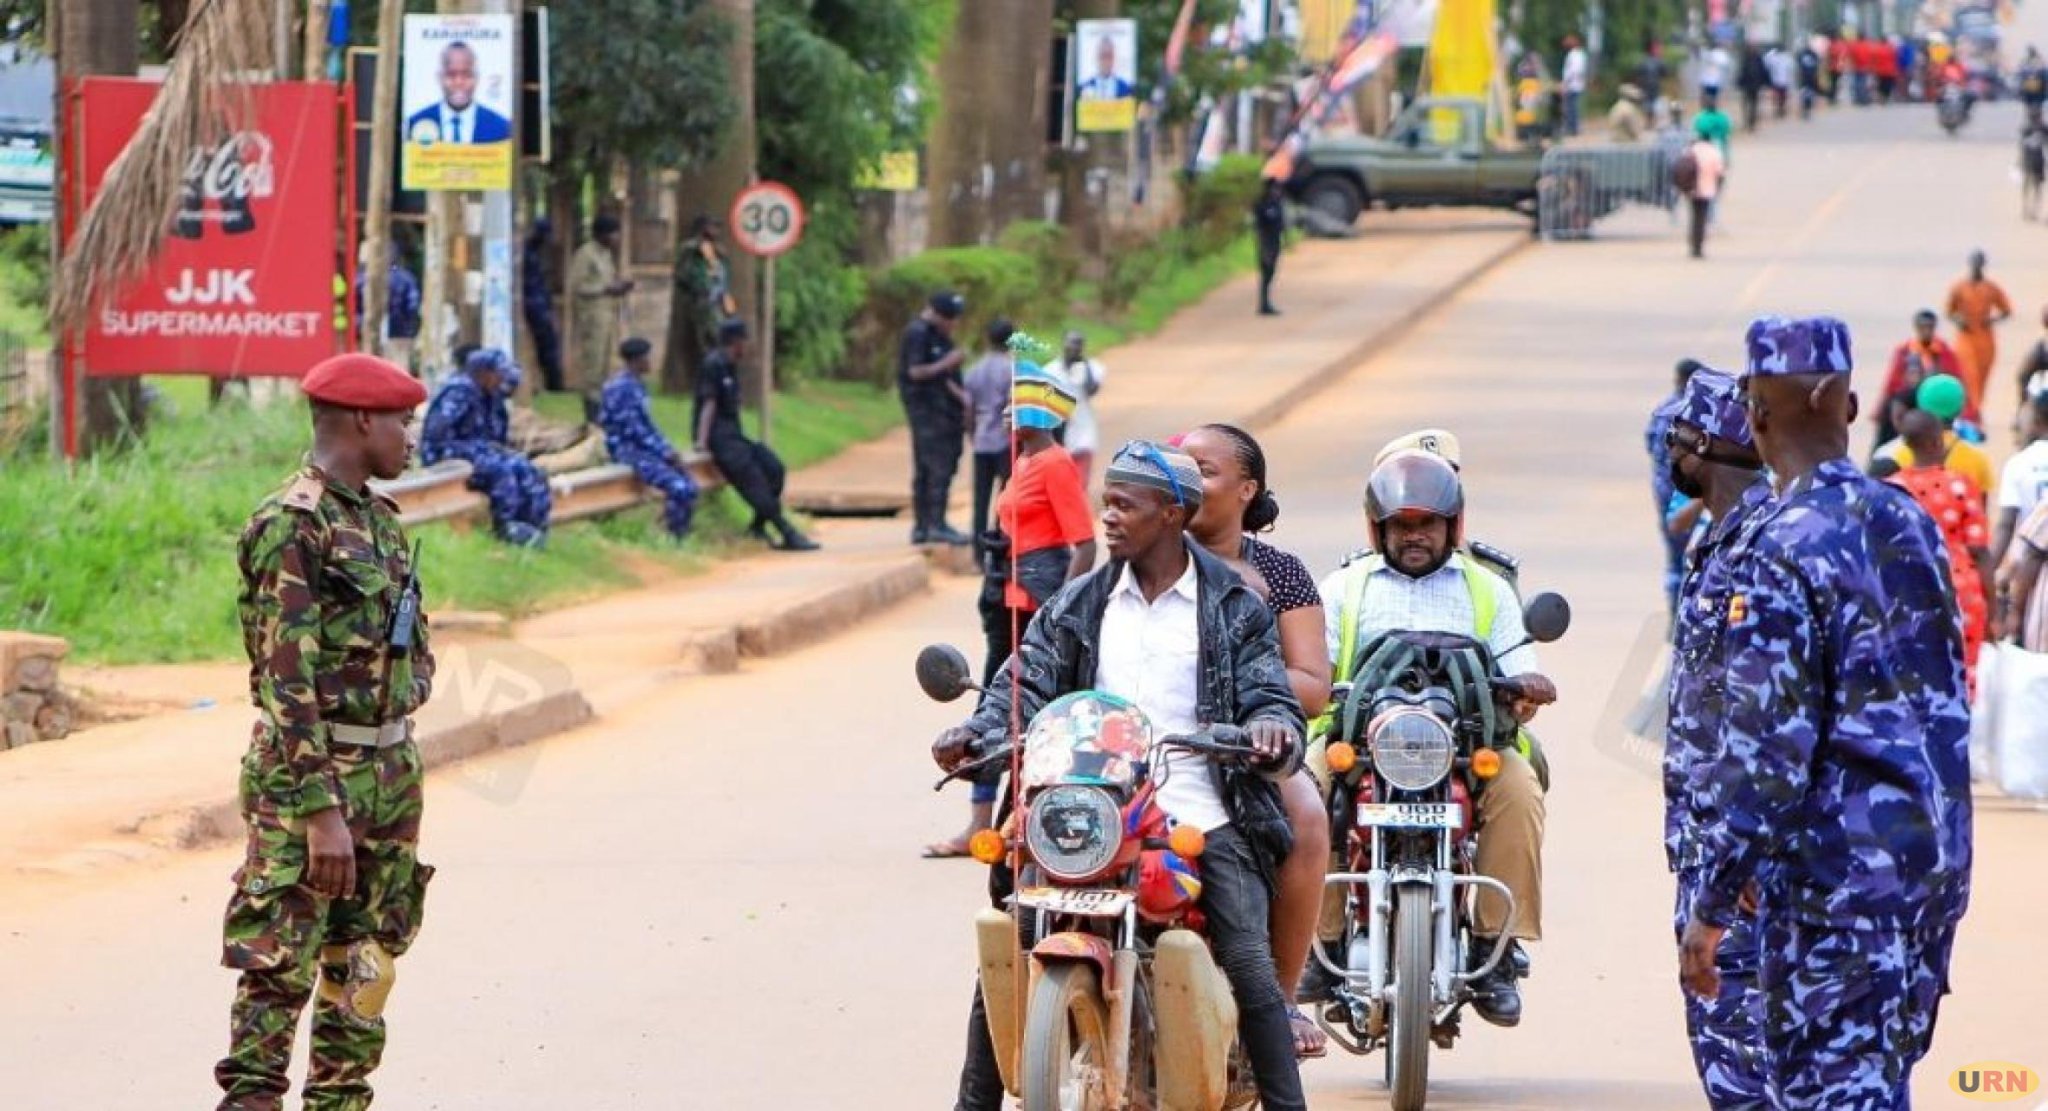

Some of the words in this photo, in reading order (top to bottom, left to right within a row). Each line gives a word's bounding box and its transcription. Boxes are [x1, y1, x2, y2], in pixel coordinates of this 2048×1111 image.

[743, 203, 789, 234] 30
[164, 268, 256, 304] JJK
[102, 311, 321, 336] SUPERMARKET
